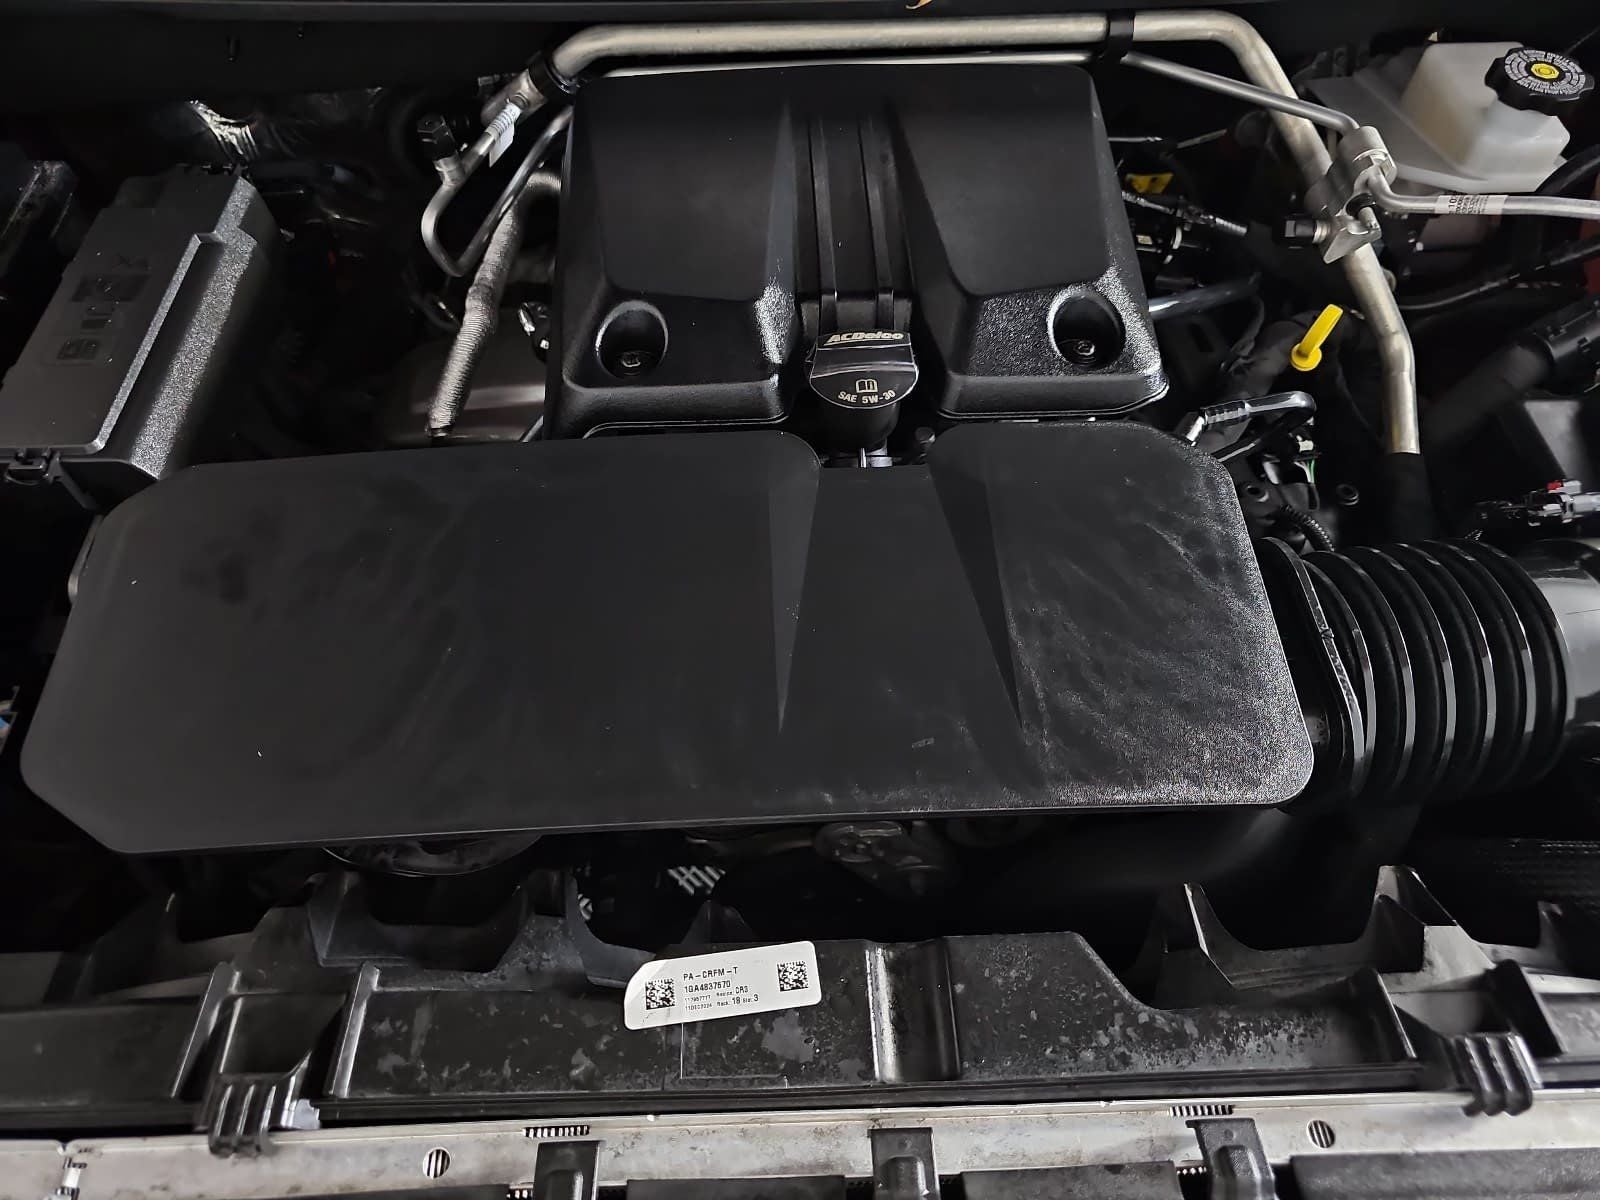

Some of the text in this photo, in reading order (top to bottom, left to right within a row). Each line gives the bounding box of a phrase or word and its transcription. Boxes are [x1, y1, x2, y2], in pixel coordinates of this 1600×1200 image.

[827, 331, 904, 343] ACDelco
[838, 390, 896, 404] SAE 5W-30
[753, 994, 759, 1002] 3
